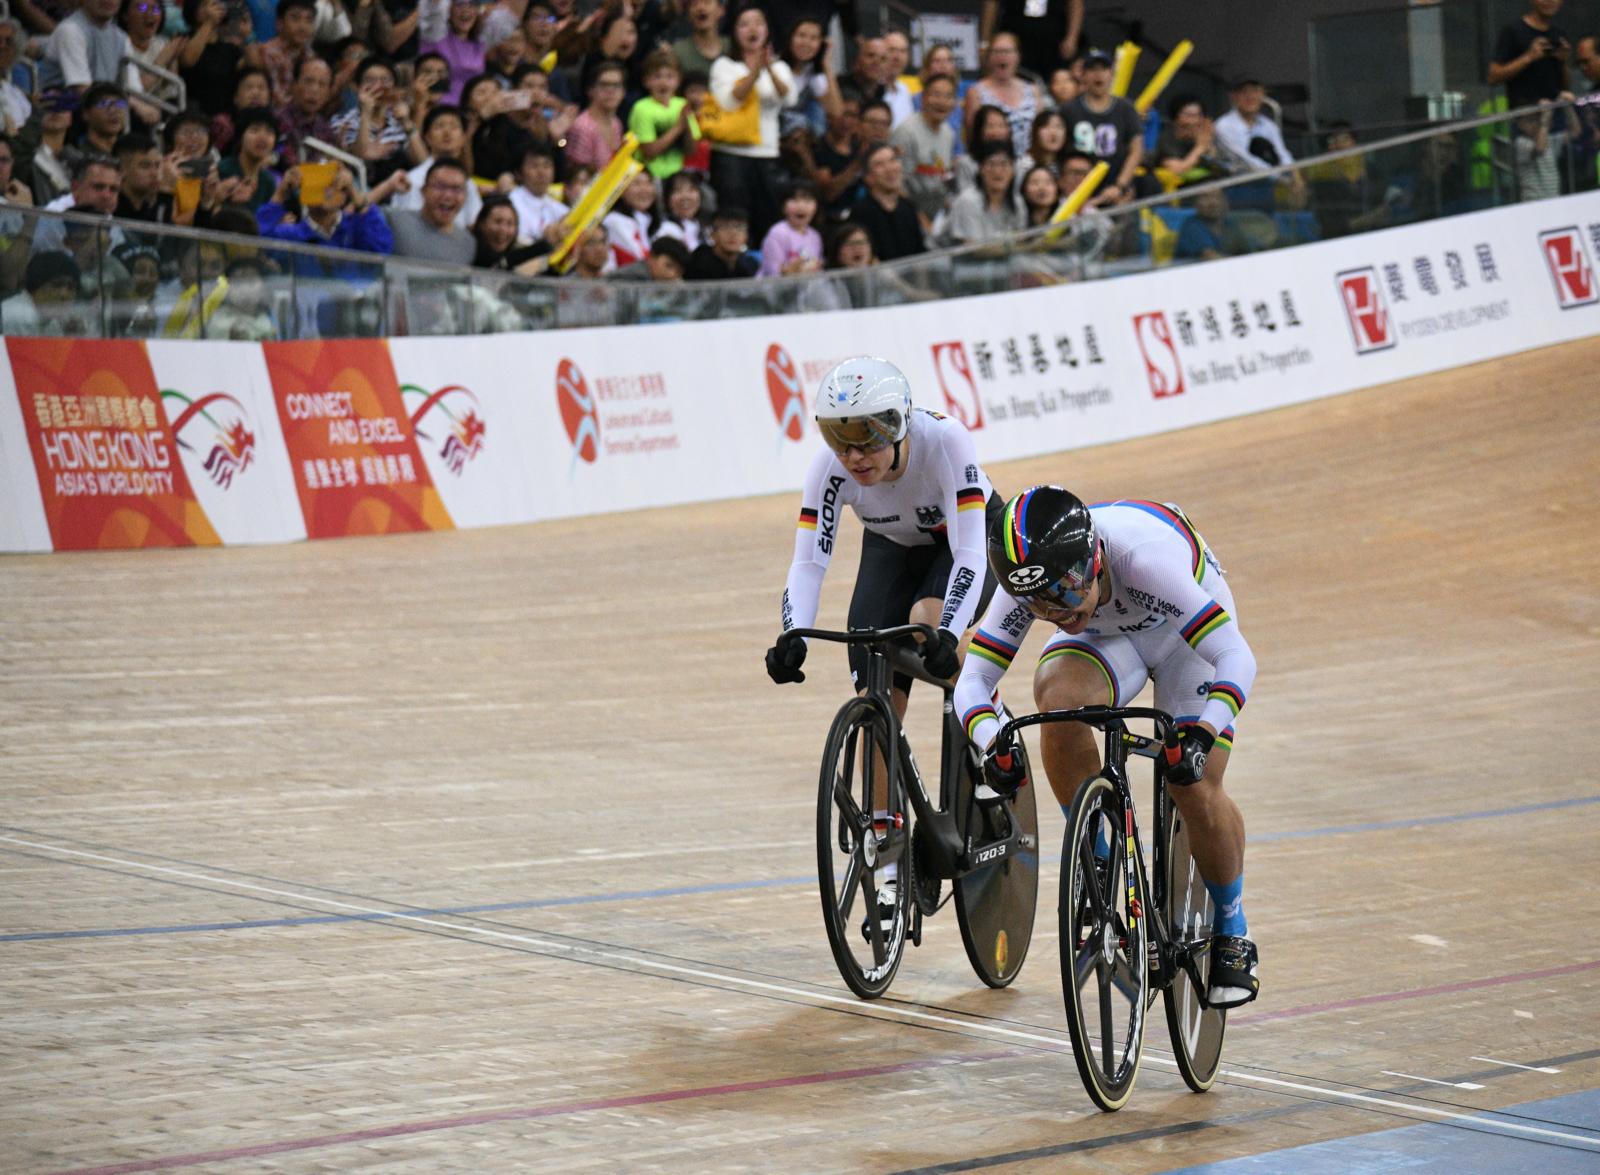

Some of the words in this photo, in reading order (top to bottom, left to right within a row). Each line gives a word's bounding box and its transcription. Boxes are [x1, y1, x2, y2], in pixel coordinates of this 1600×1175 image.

[285, 392, 353, 419] CONNECT
[328, 420, 359, 445] AND
[360, 417, 406, 443] EXCEL
[818, 475, 846, 556] ŠKODA
[1157, 598, 1184, 618] water
[1118, 614, 1158, 633] HKT
